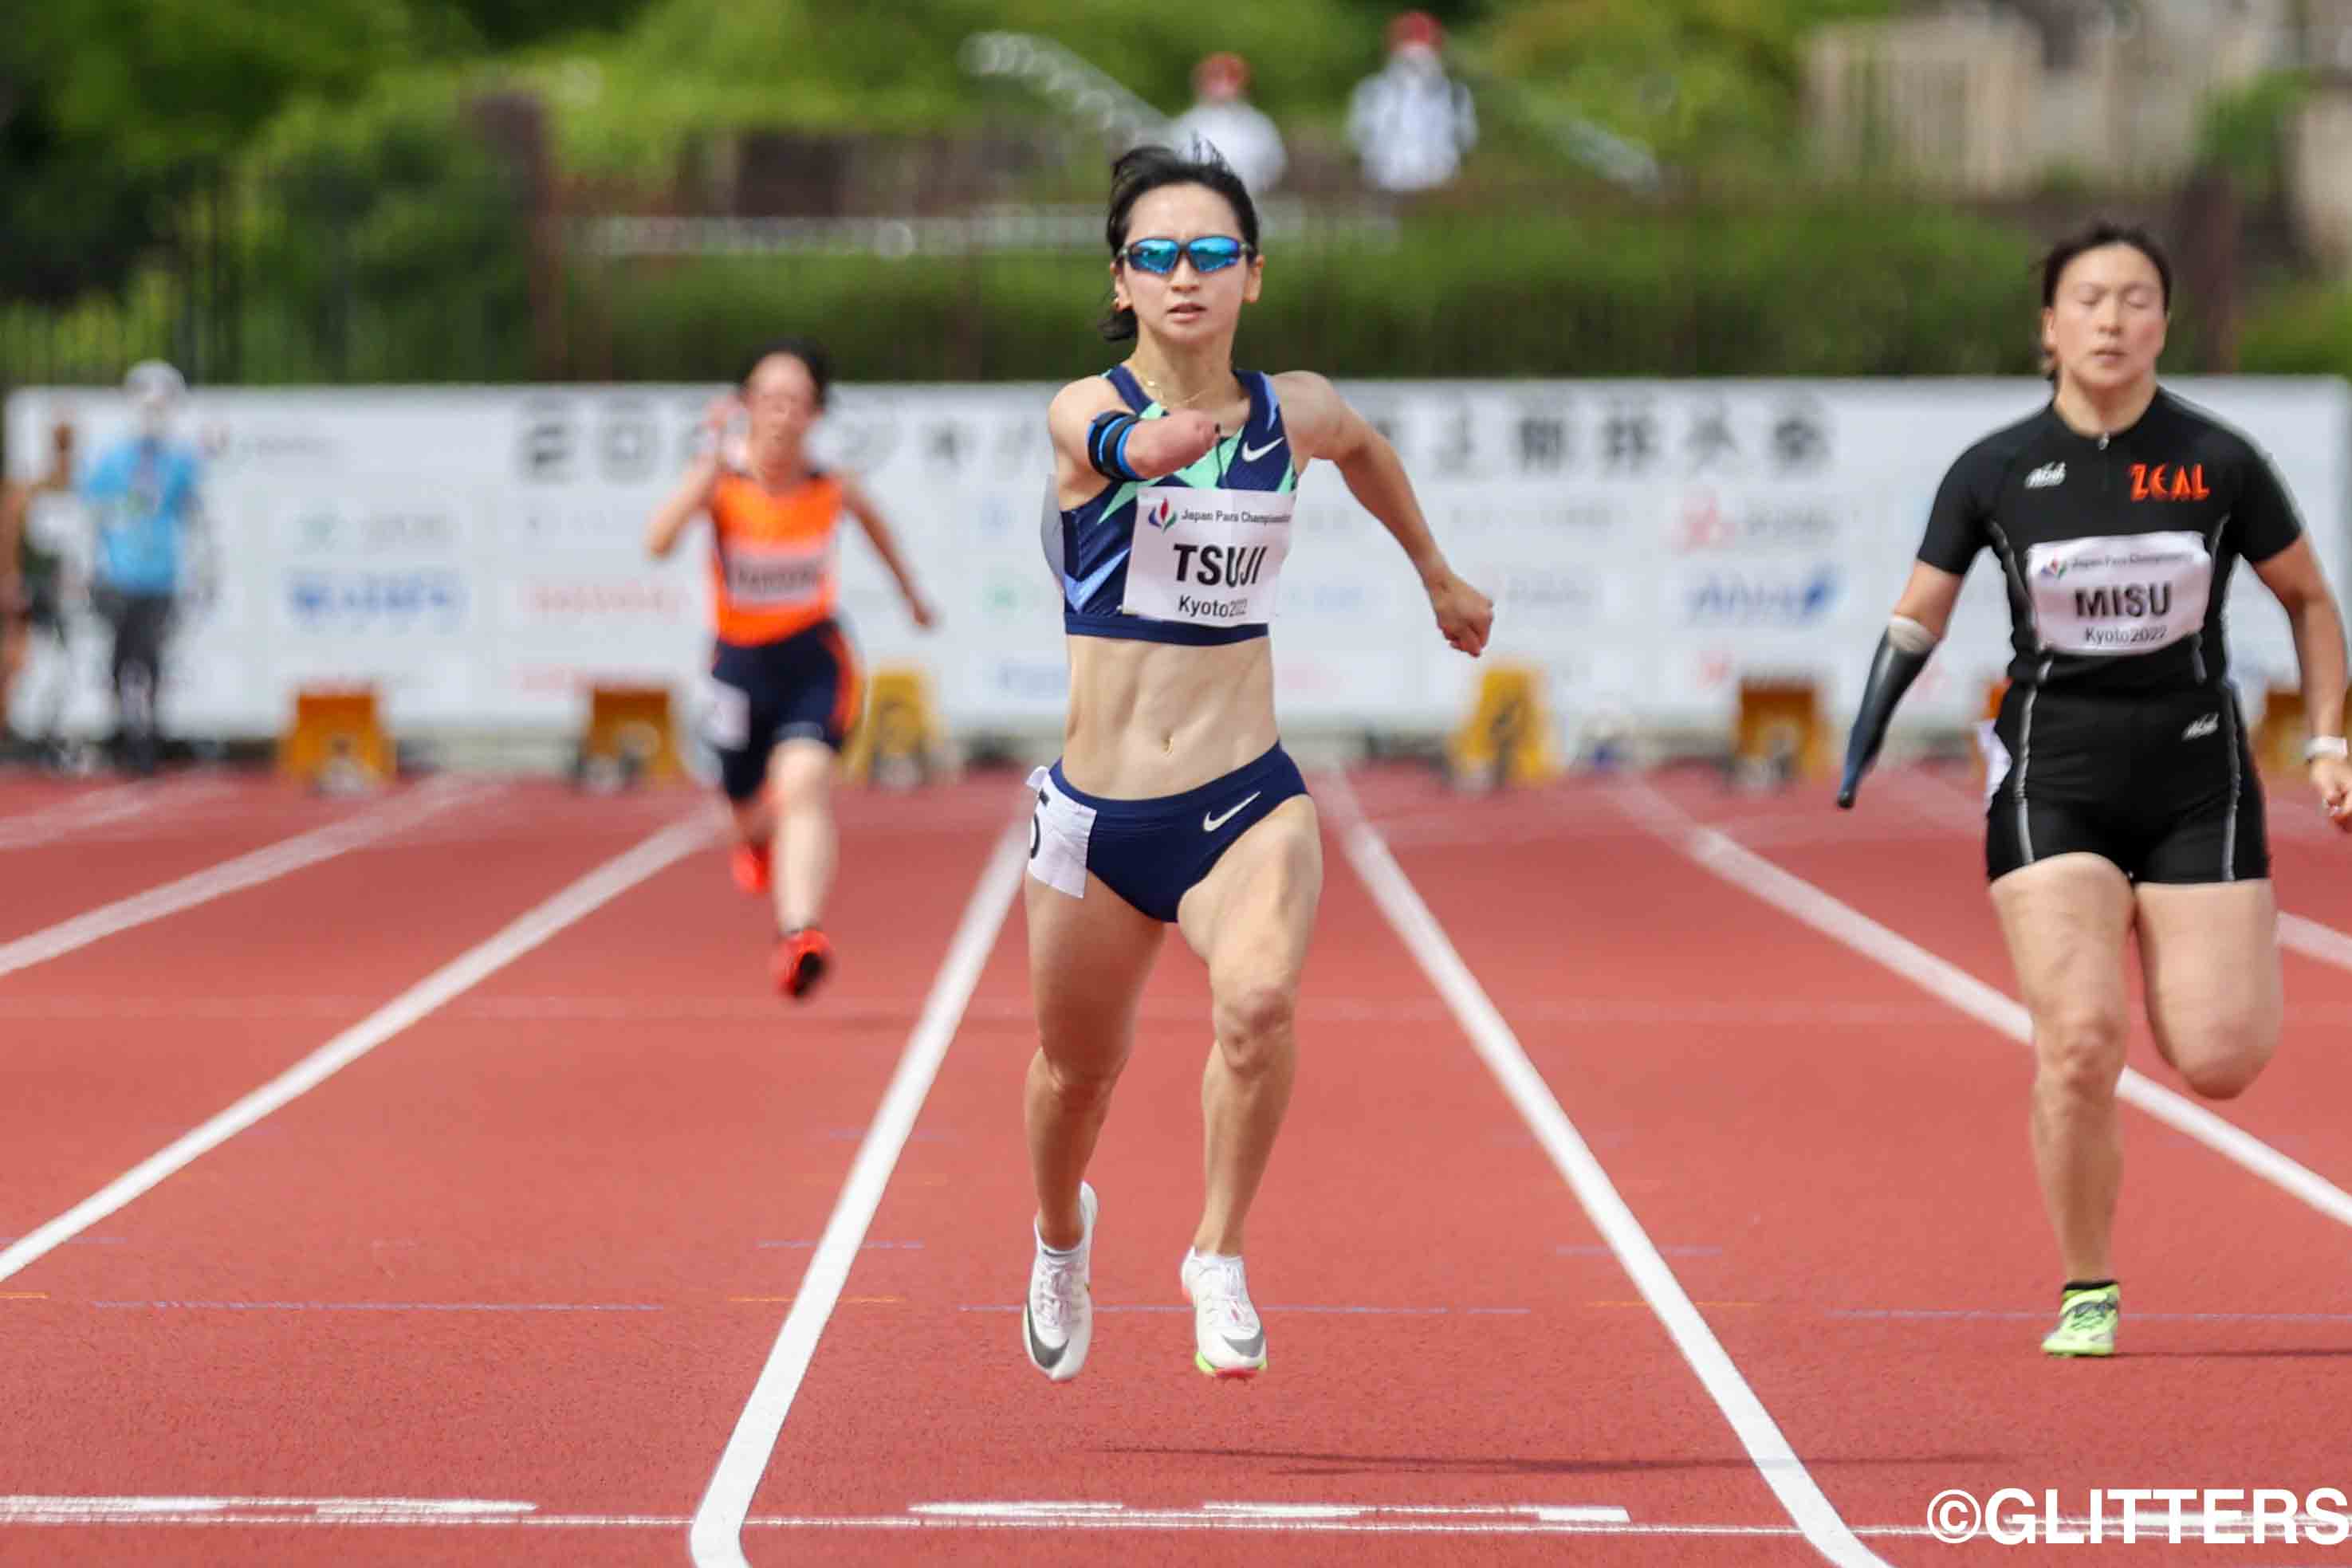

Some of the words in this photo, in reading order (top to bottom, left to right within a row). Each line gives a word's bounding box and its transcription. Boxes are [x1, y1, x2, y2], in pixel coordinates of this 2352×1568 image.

[2130, 462, 2211, 501] ZEAL
[1182, 508, 1213, 523] Japan
[1216, 510, 1239, 522] Para
[1174, 544, 1269, 588] TSUJI
[2075, 580, 2172, 618] MISU
